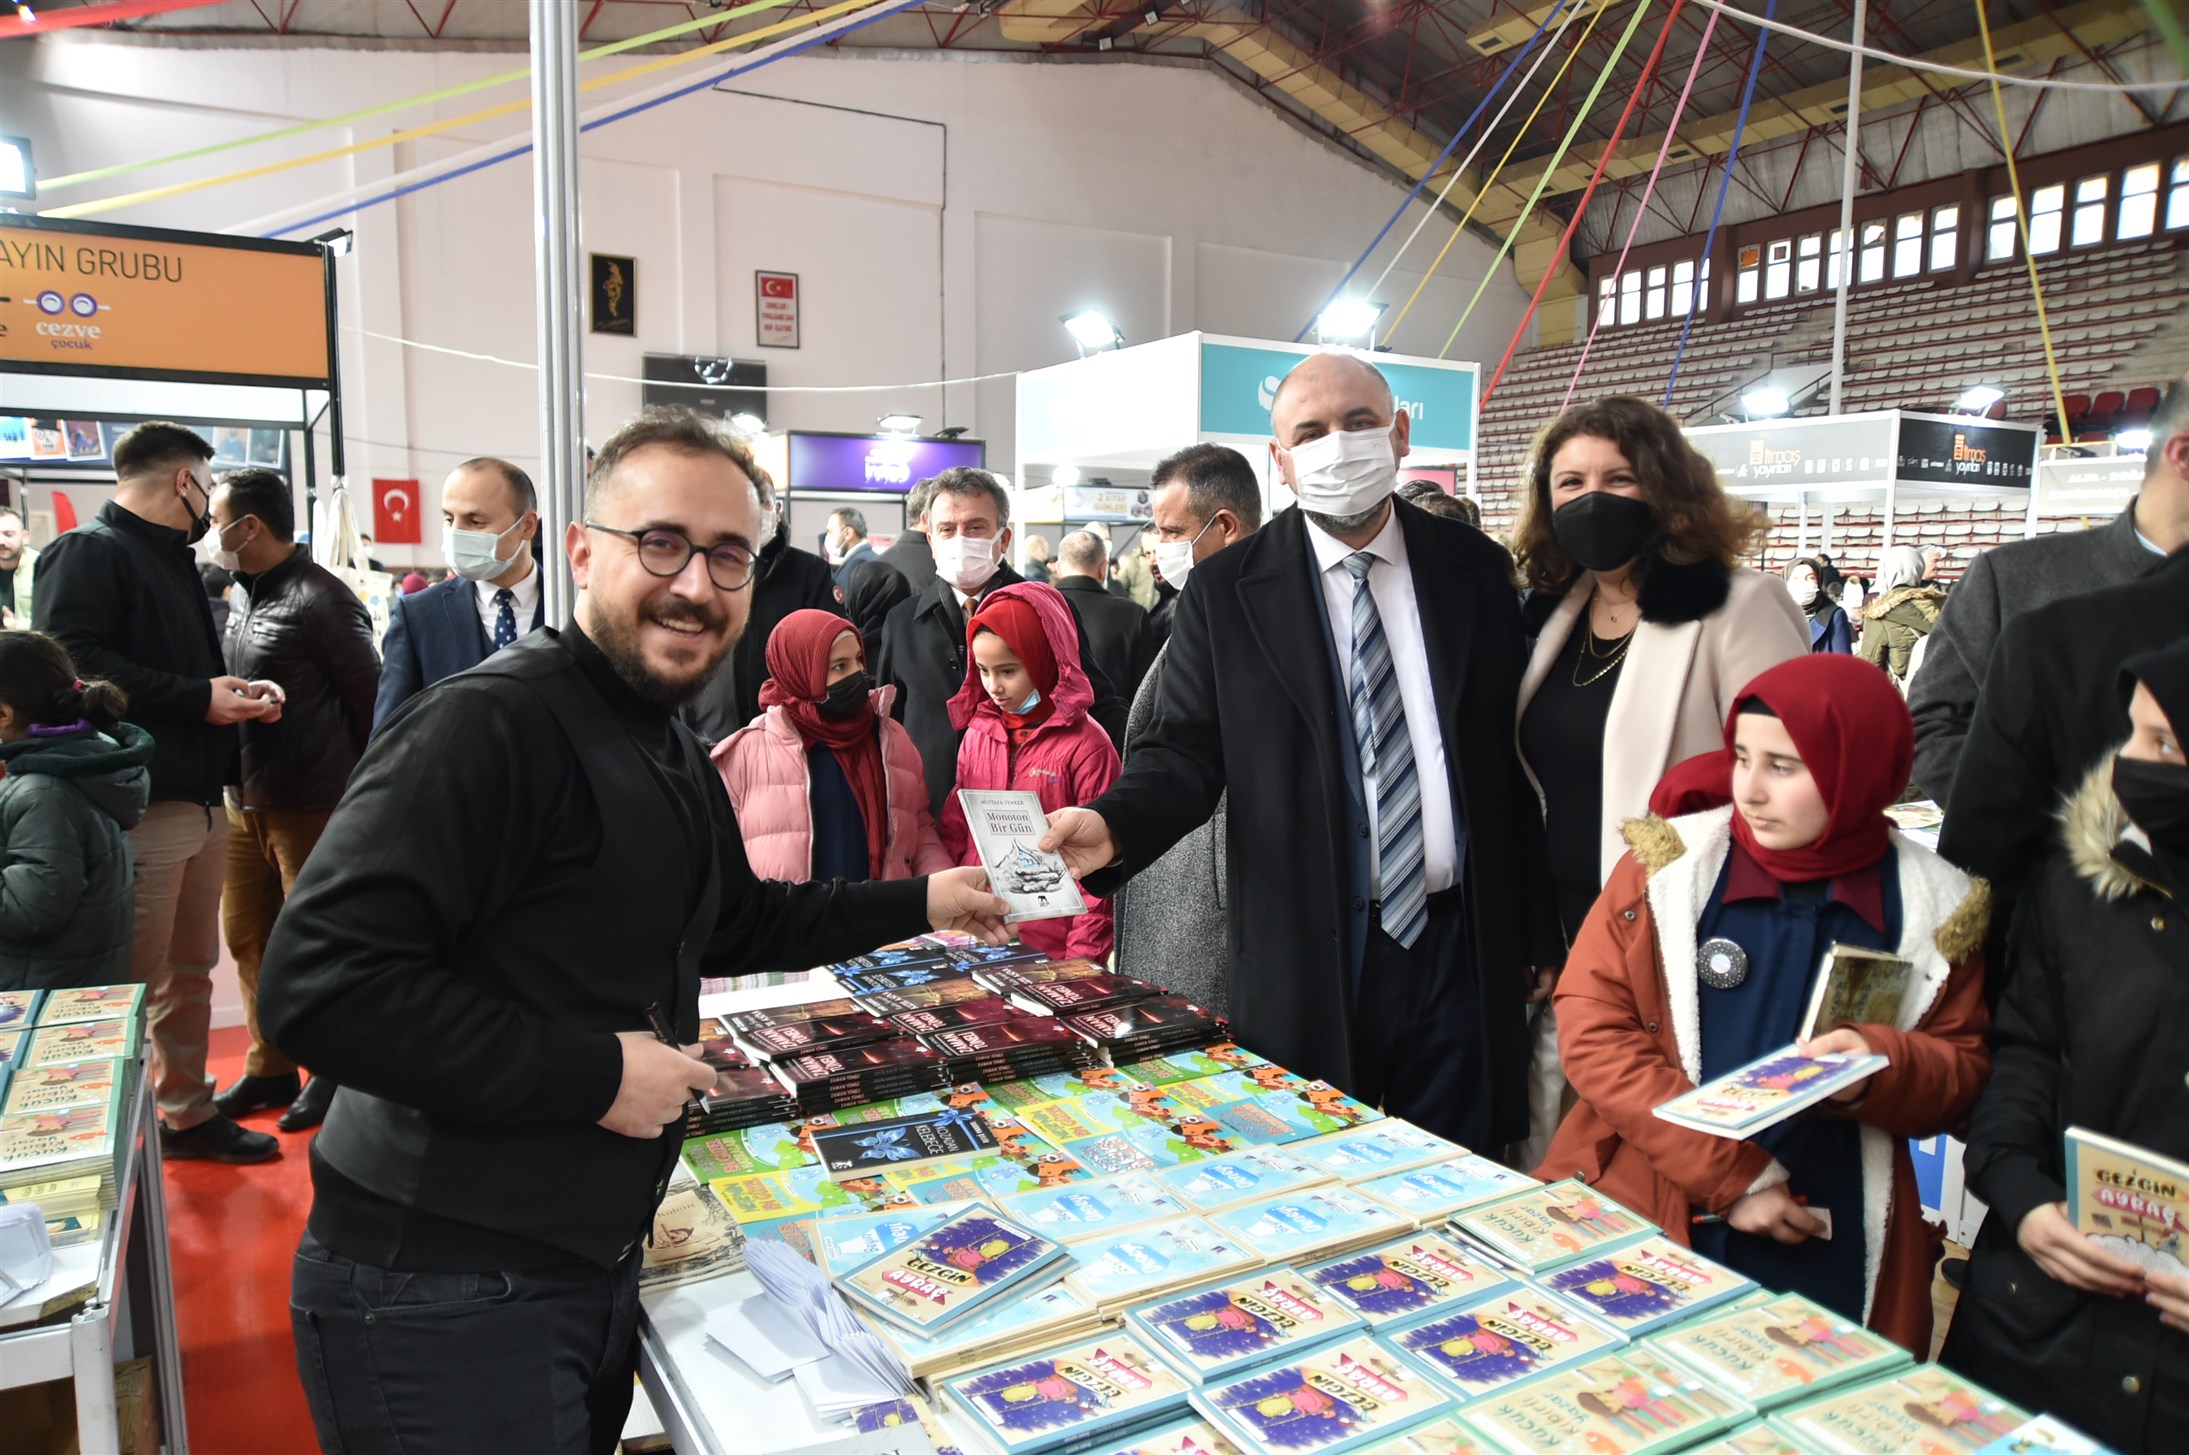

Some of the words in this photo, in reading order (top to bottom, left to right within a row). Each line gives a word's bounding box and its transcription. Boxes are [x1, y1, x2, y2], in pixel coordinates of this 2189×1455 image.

[77, 248, 182, 283] GRUBU
[36, 321, 101, 340] cezve
[51, 339, 93, 350] çocuk
[986, 812, 1029, 822] Monoton
[990, 823, 1007, 833] Bir
[1009, 823, 1032, 833] Gün
[761, 1029, 798, 1049] ZAMAN
[942, 1032, 974, 1053] ZAMAN
[797, 1055, 830, 1077] ZAMAN
[2100, 1188, 2176, 1227] AYRAÇ
[906, 1258, 972, 1283] GEZGİN
[1409, 1251, 1467, 1281] AYRAÇ
[1639, 1255, 1703, 1285] AYRAÇ
[888, 1269, 949, 1300] AYRAÇ
[1260, 1287, 1317, 1320] AYRAÇ
[1505, 1308, 1571, 1342] AYRAÇ
[1089, 1354, 1145, 1389] AYRAÇ
[1337, 1362, 1401, 1400] AYRAÇ
